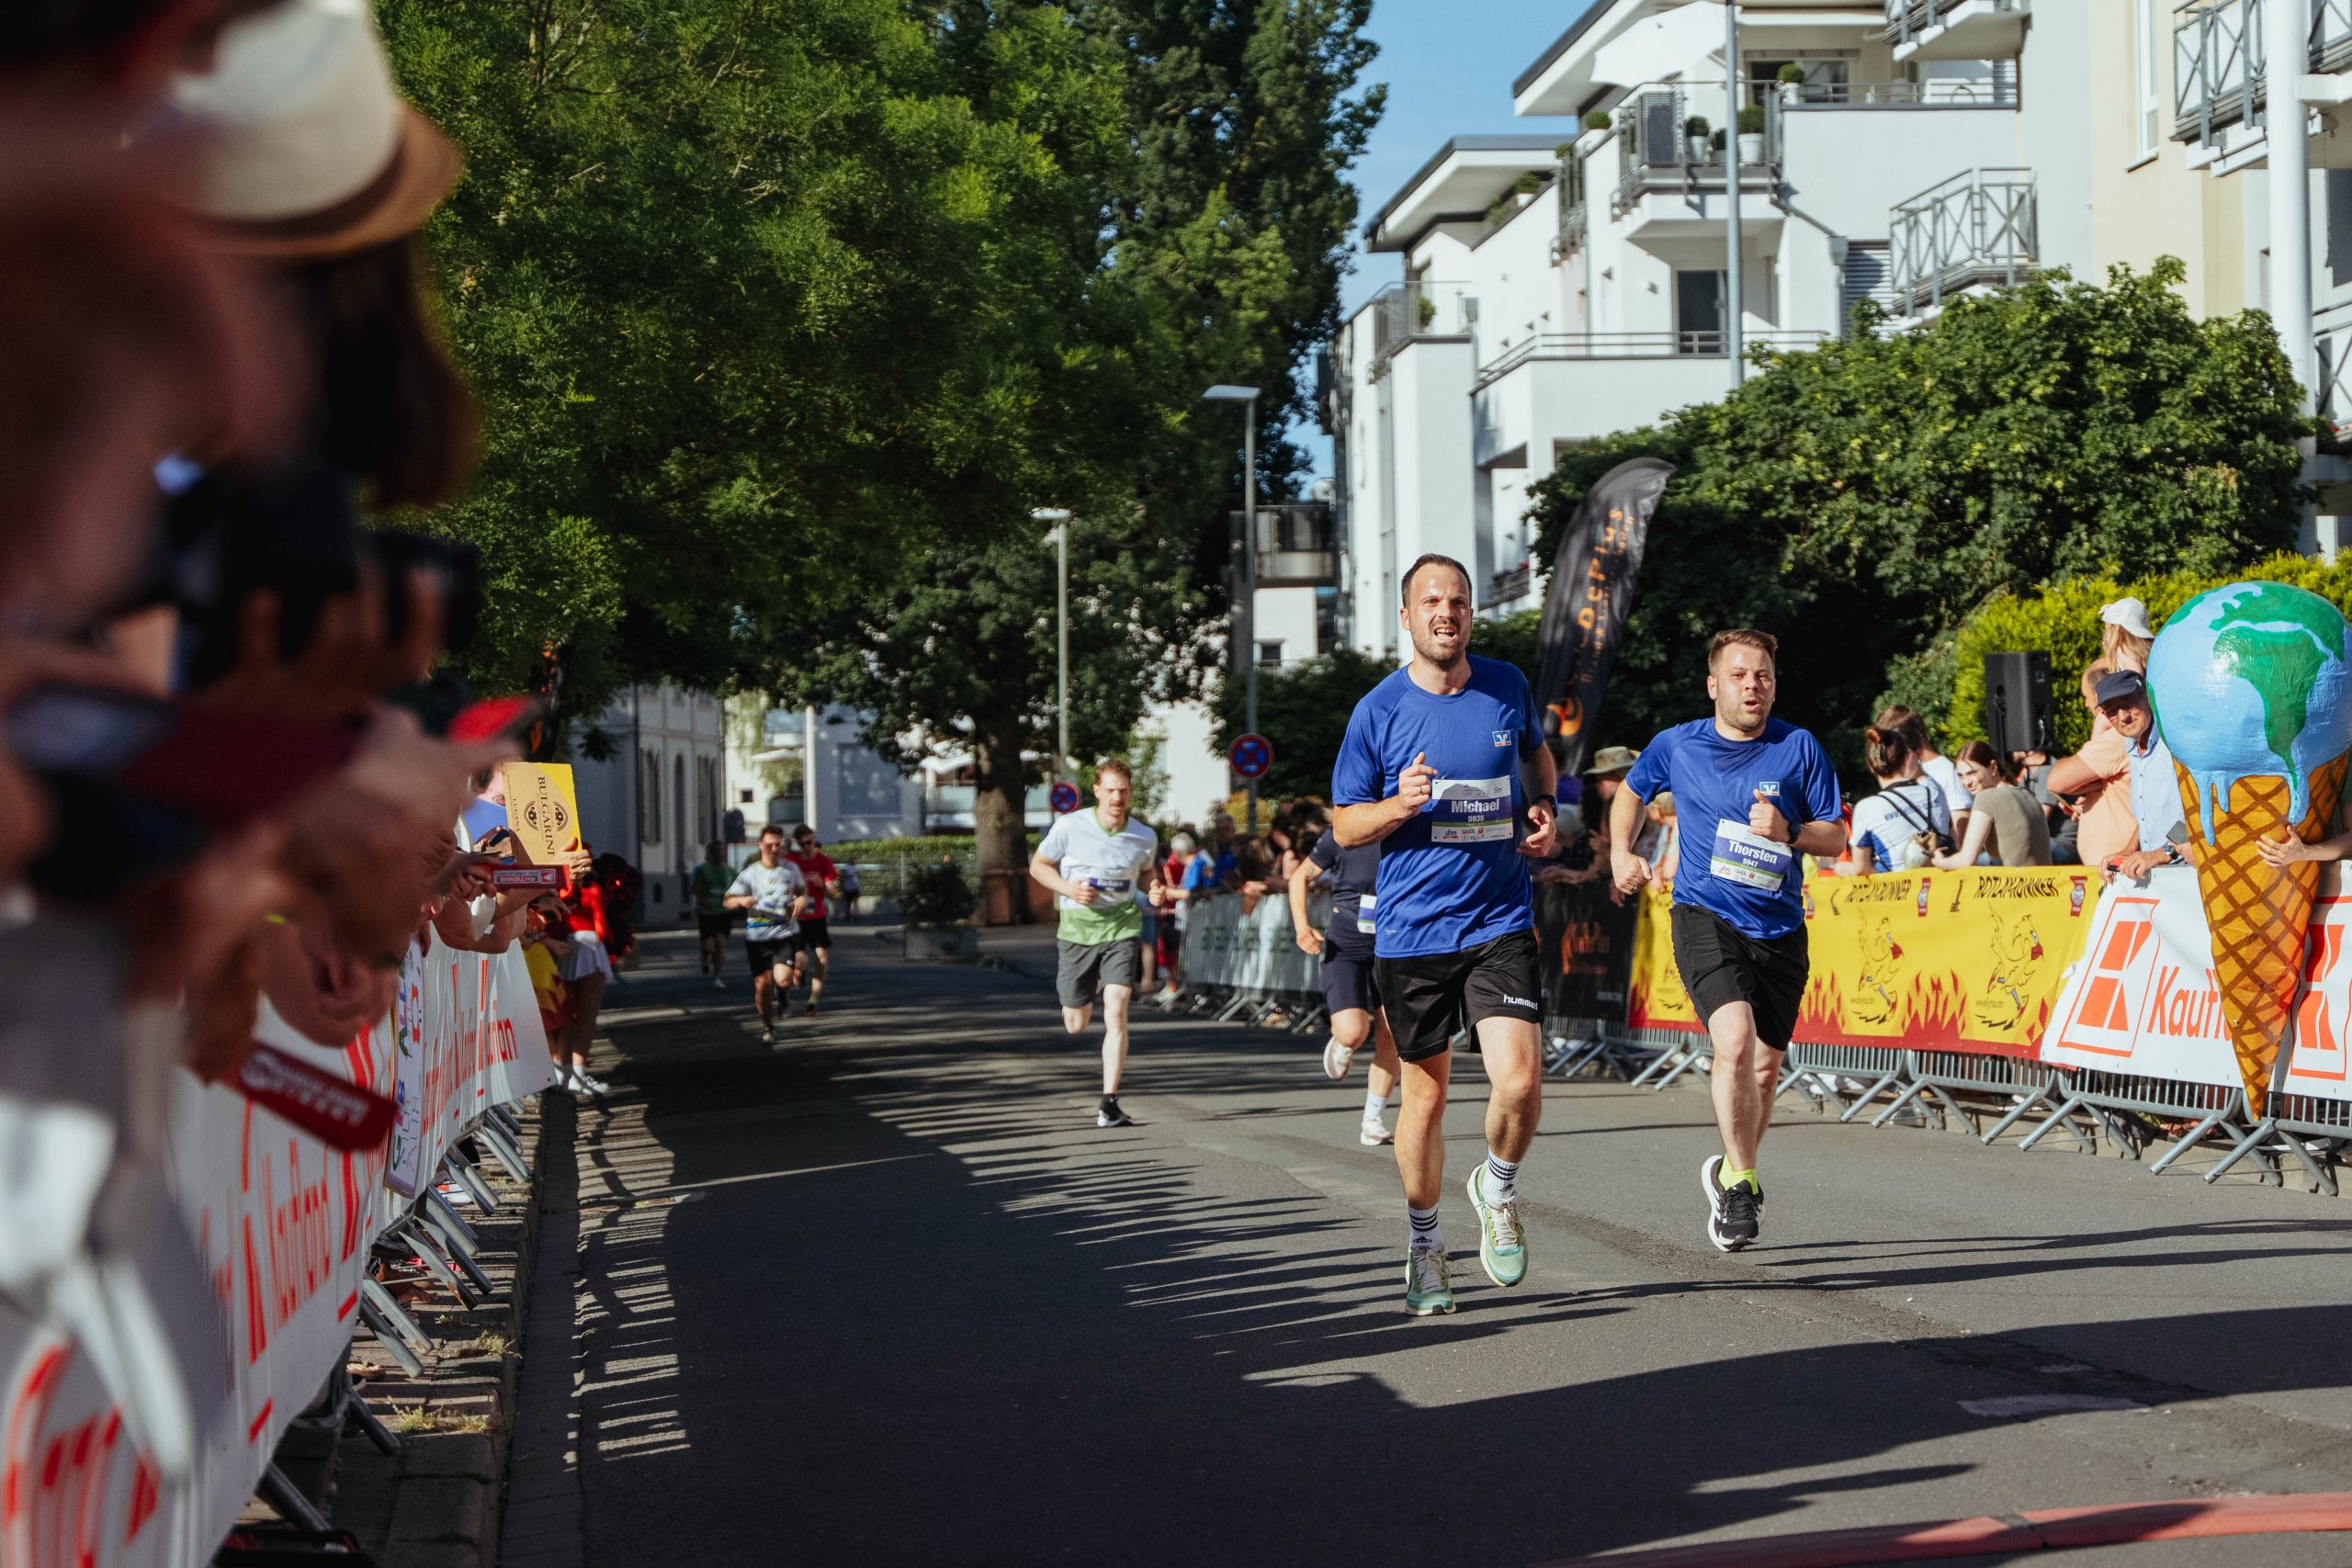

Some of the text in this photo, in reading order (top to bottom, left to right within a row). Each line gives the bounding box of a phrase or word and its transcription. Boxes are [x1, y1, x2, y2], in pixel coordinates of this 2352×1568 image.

[1451, 798, 1499, 813] Michael
[537, 776, 555, 855] BULGARINI
[1467, 815, 1485, 823] 5935
[1728, 840, 1778, 864] Thorsten
[1742, 857, 1759, 868] 5947
[1503, 993, 1538, 1011] hummel
